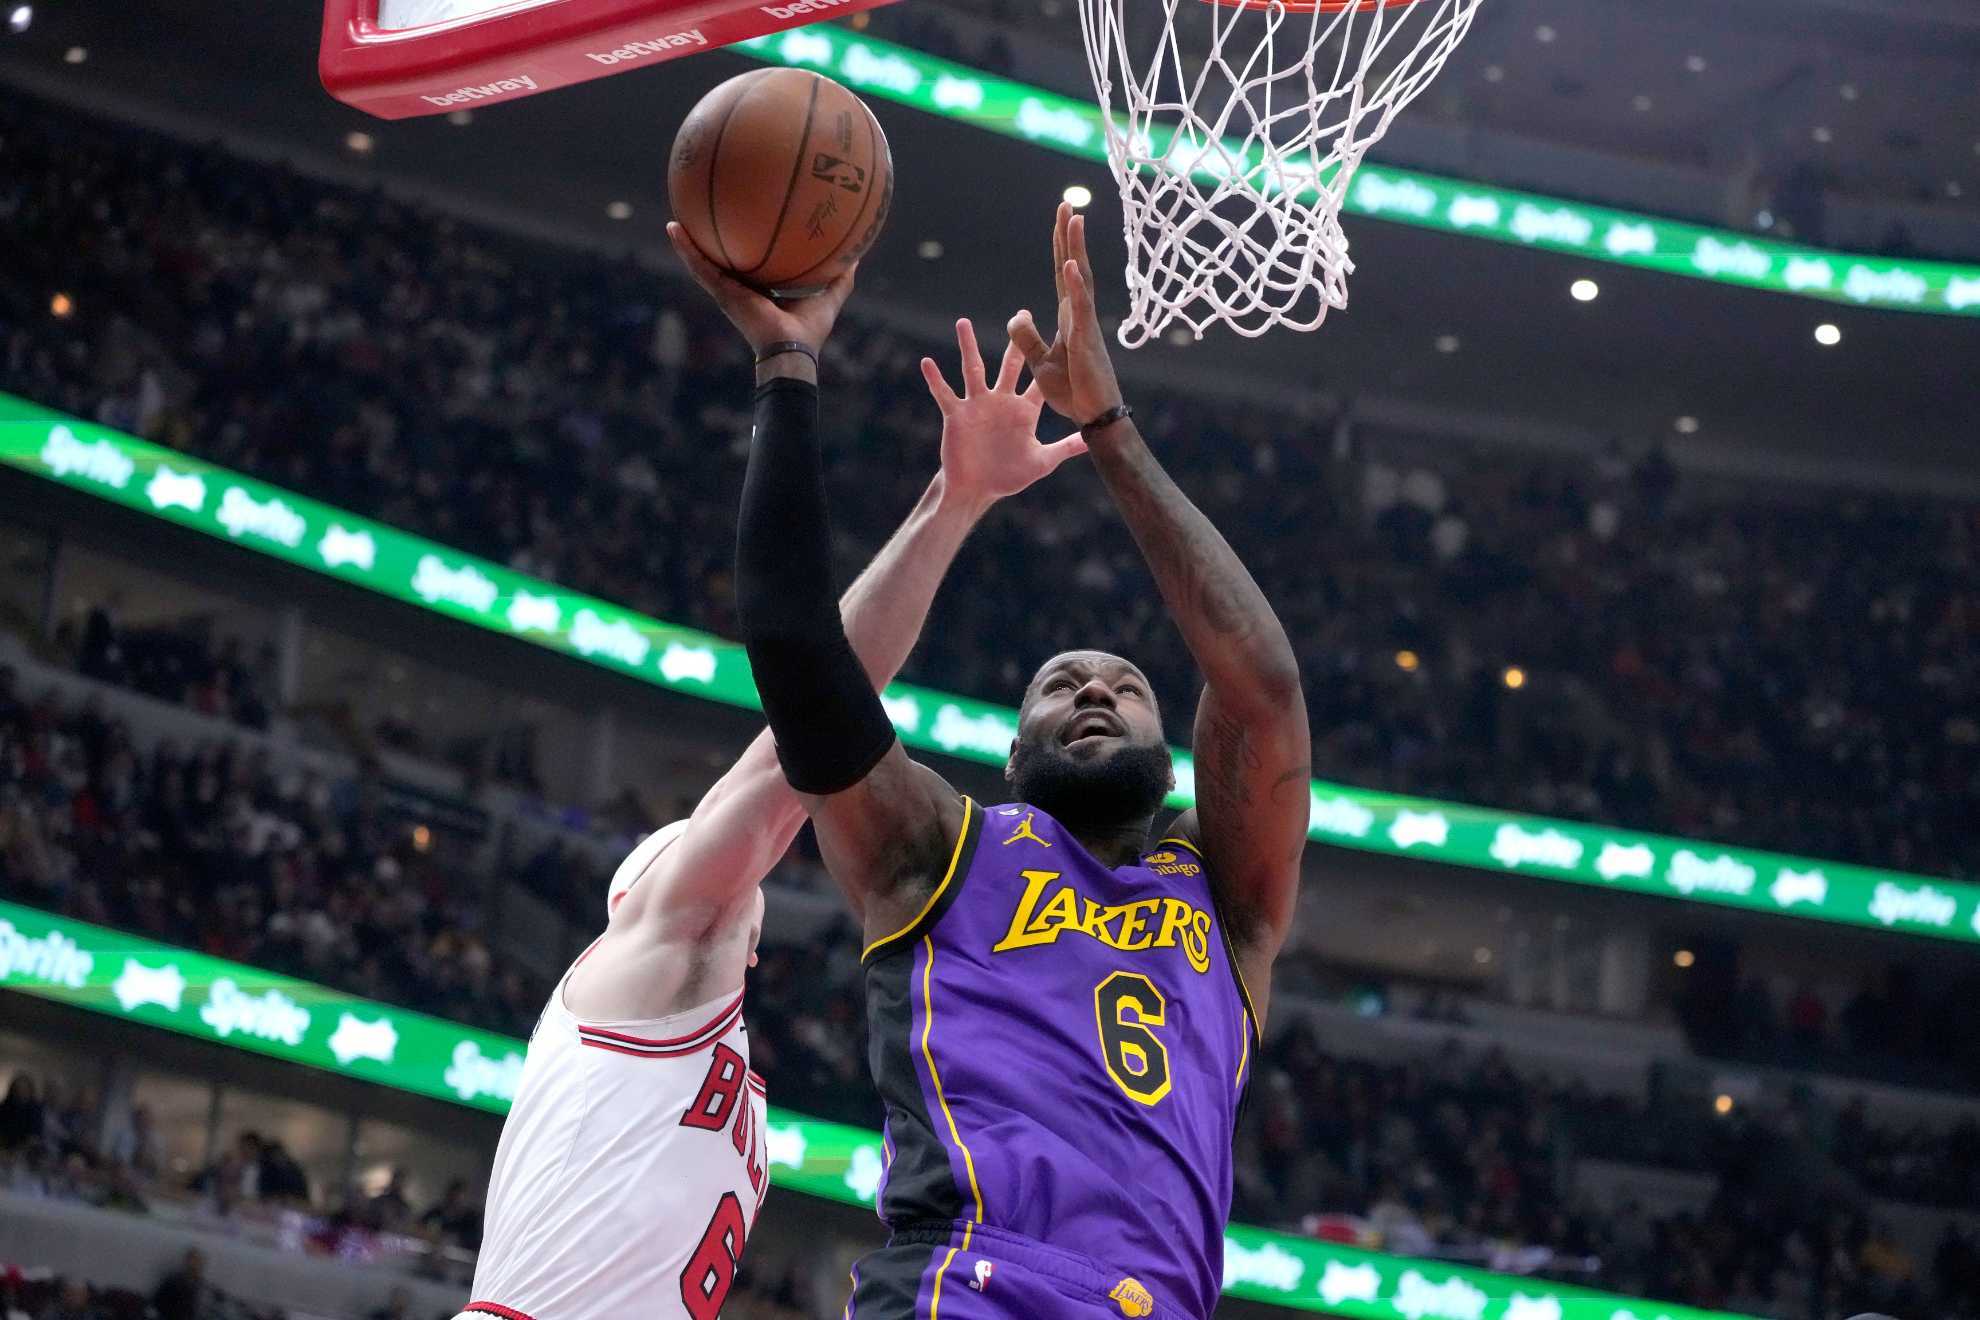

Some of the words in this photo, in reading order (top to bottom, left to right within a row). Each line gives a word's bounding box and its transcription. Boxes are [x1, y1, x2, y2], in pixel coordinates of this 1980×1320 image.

[585, 29, 708, 65] betway
[760, 0, 850, 19] bet
[420, 75, 538, 106] betway
[993, 869, 1213, 974] LAKERS
[1094, 970, 1172, 1107] 6
[679, 1042, 769, 1225] BUL
[679, 1191, 747, 1320] 6
